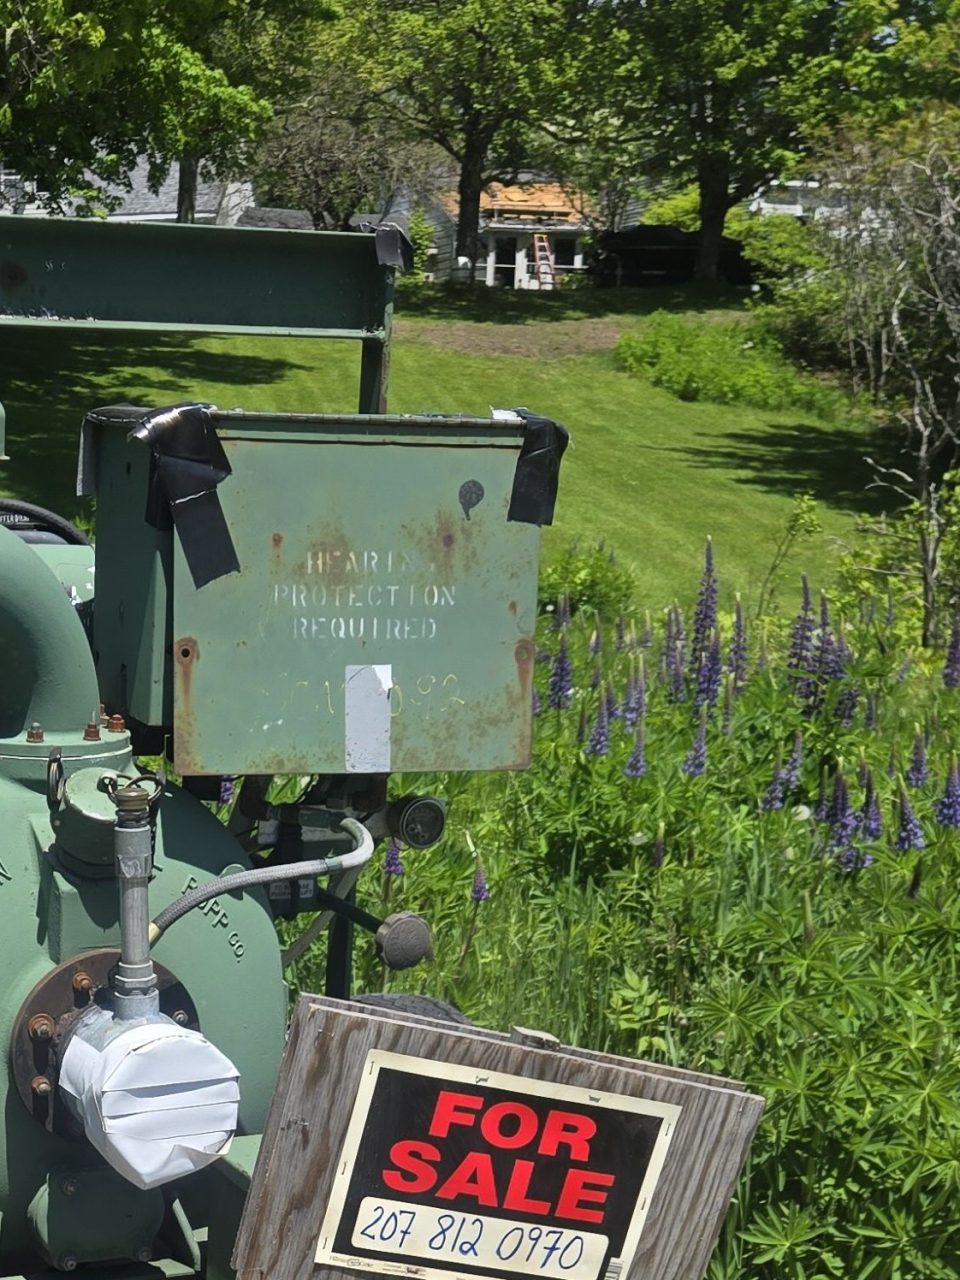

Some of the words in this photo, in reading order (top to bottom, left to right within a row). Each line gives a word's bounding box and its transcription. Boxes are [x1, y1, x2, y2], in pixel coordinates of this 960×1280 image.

[307, 551, 435, 573] HEARIN
[274, 584, 456, 607] PROTECTION
[293, 617, 436, 640] REQUIRED
[181, 873, 229, 928] RPP
[428, 1090, 598, 1162] FOR
[382, 1140, 616, 1224] SALE
[360, 1206, 416, 1248] 207
[428, 1214, 484, 1257] 812
[496, 1227, 584, 1270] 0970
